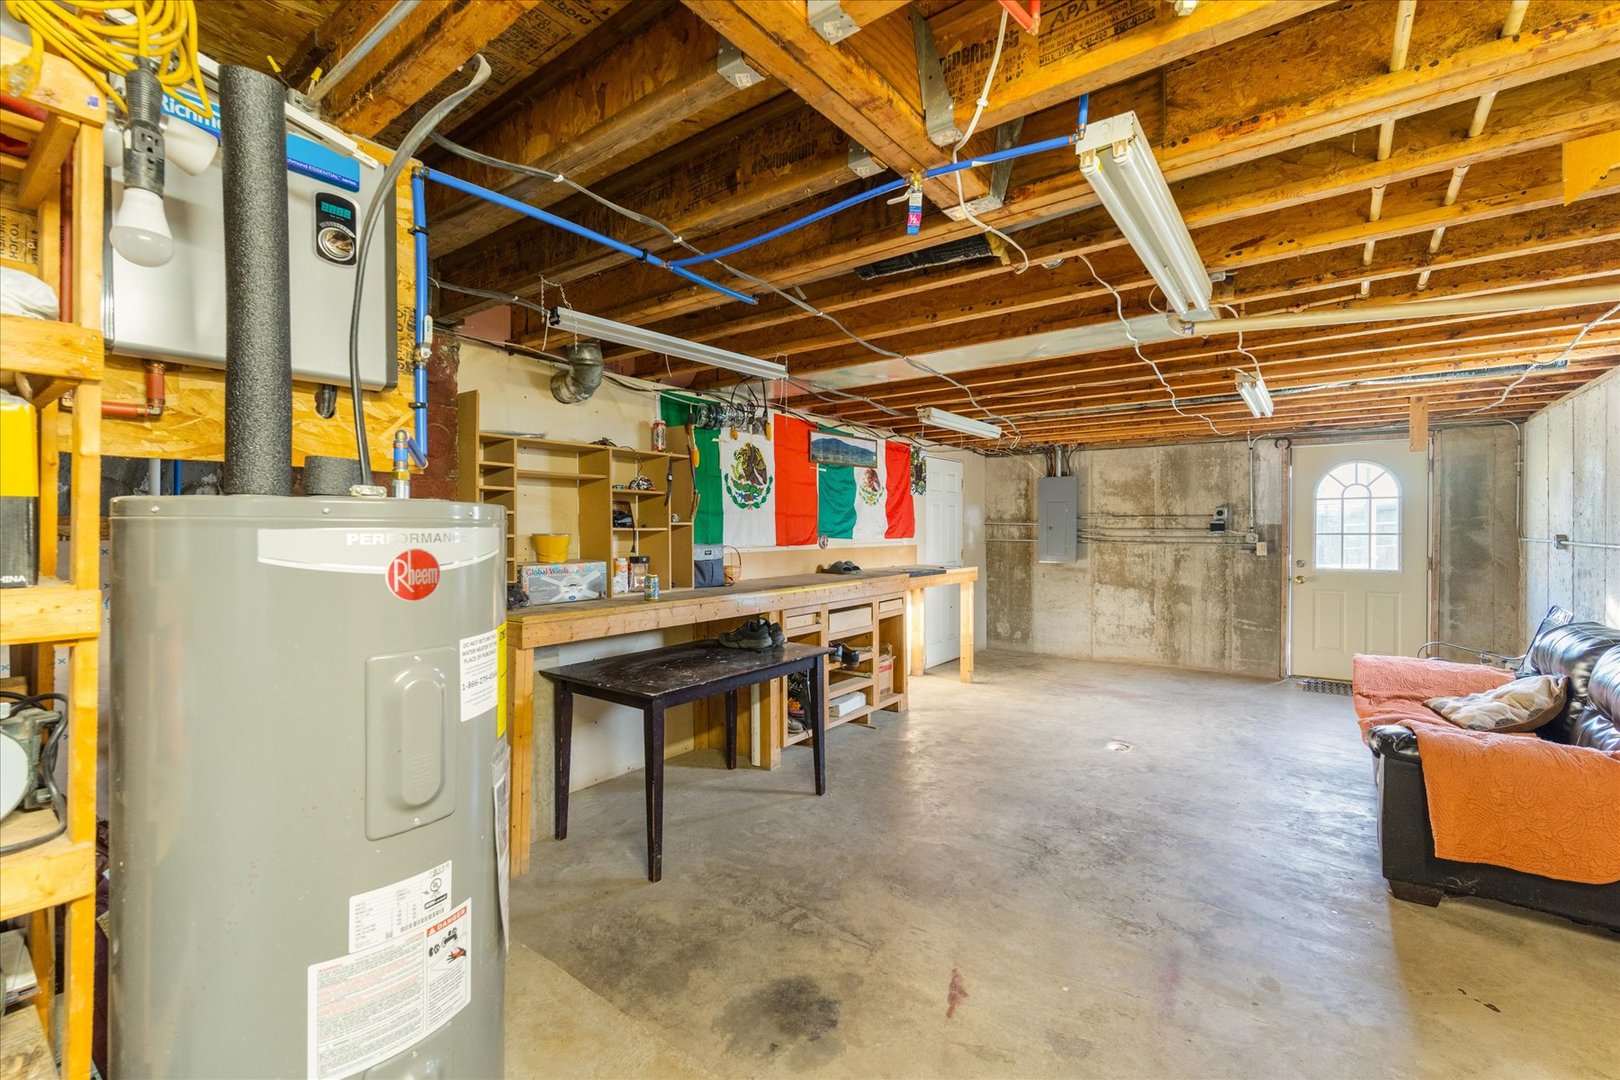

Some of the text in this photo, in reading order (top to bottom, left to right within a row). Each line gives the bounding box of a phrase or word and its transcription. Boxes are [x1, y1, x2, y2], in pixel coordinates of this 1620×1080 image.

[346, 532, 468, 546] PERFORMANCE
[393, 550, 439, 593] Rheem
[526, 568, 547, 577] Global
